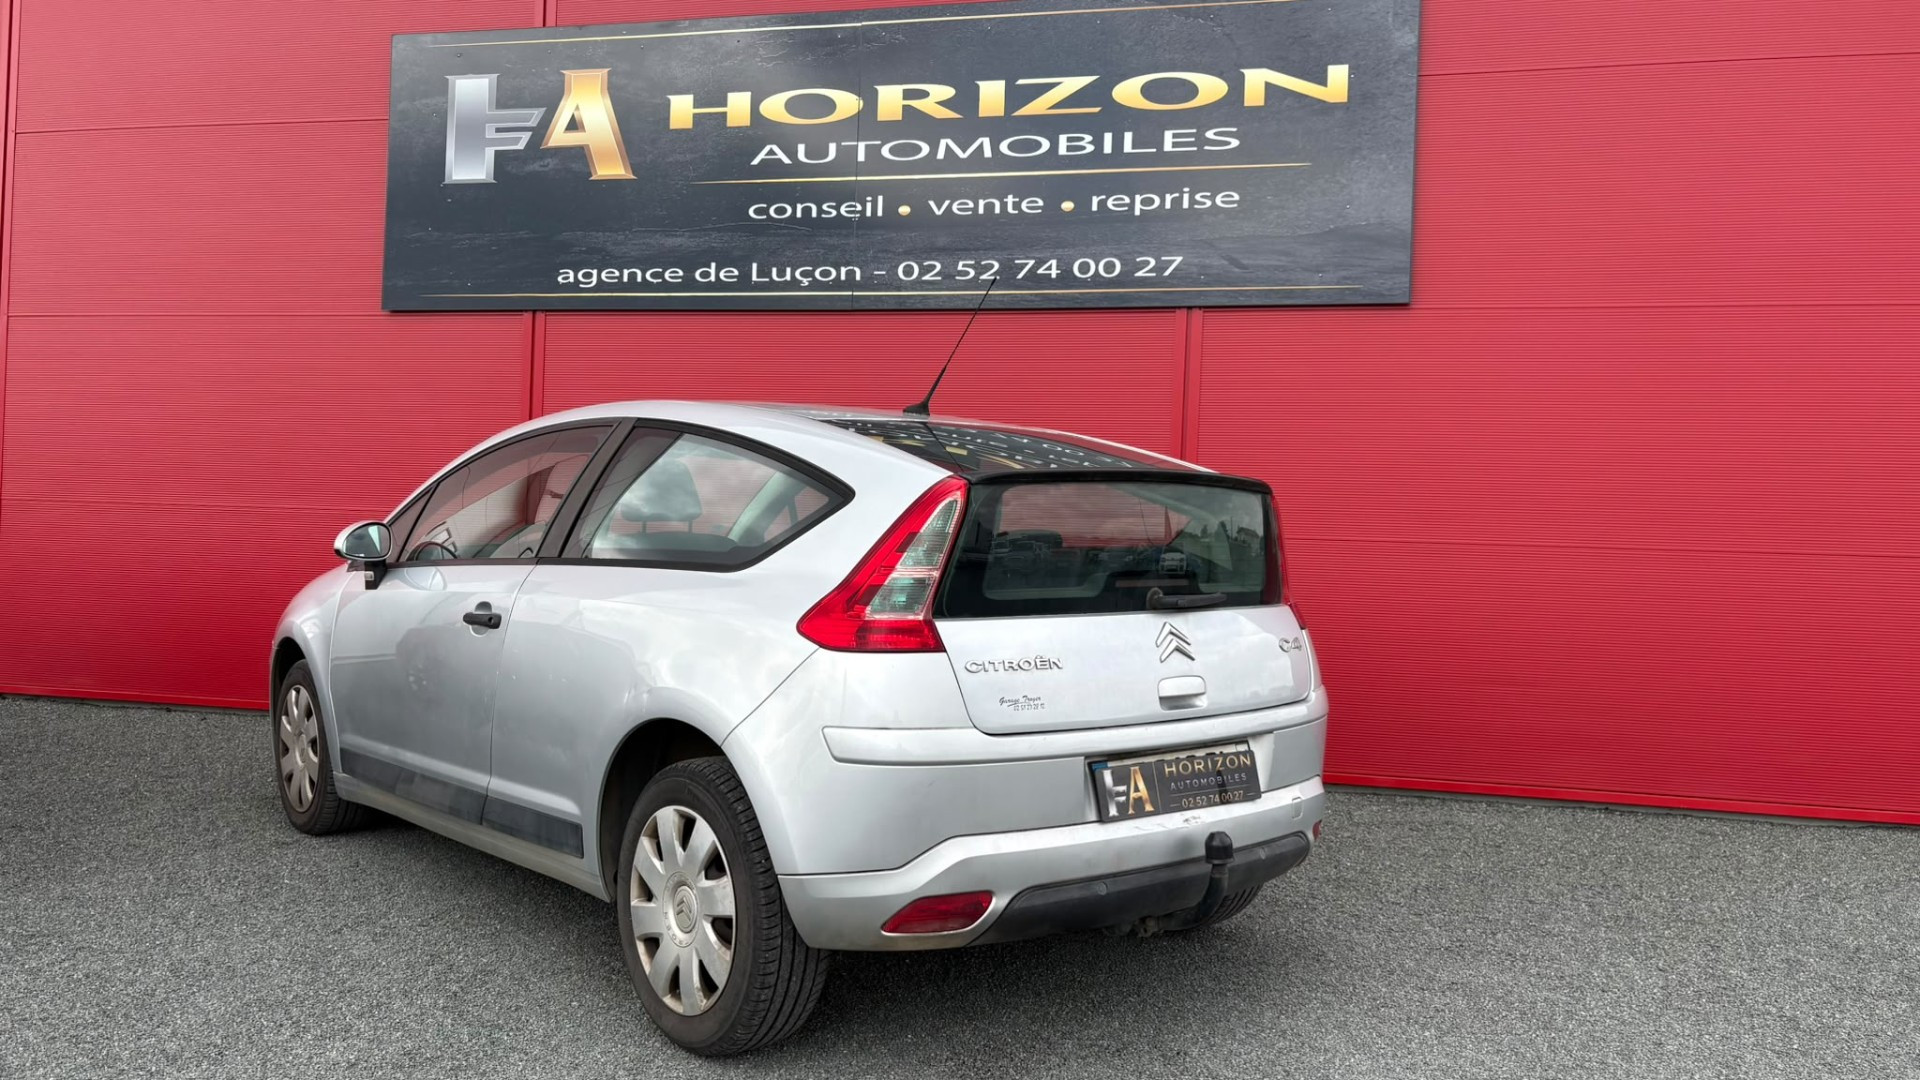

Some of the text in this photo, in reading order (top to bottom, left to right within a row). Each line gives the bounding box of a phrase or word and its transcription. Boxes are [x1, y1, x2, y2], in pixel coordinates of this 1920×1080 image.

[666, 63, 1350, 130] HORIZON
[750, 127, 1242, 166] AUTOMOBILES
[748, 187, 1241, 219] conseil vente reprise
[557, 266, 685, 288] agence
[694, 262, 739, 283] de
[751, 262, 862, 288] Luçon
[897, 260, 942, 281] 02
[955, 259, 1001, 281] 52
[1014, 258, 1061, 280] 74
[1072, 257, 1122, 279] 00
[1133, 255, 1185, 278] 27
[1278, 636, 1302, 653] C4
[964, 654, 1063, 674] CITROËN
[1163, 753, 1251, 778] HORIZON
[1170, 772, 1247, 791] AUTOMOBILES
[1181, 790, 1244, 809] 02 52 74 00 27
